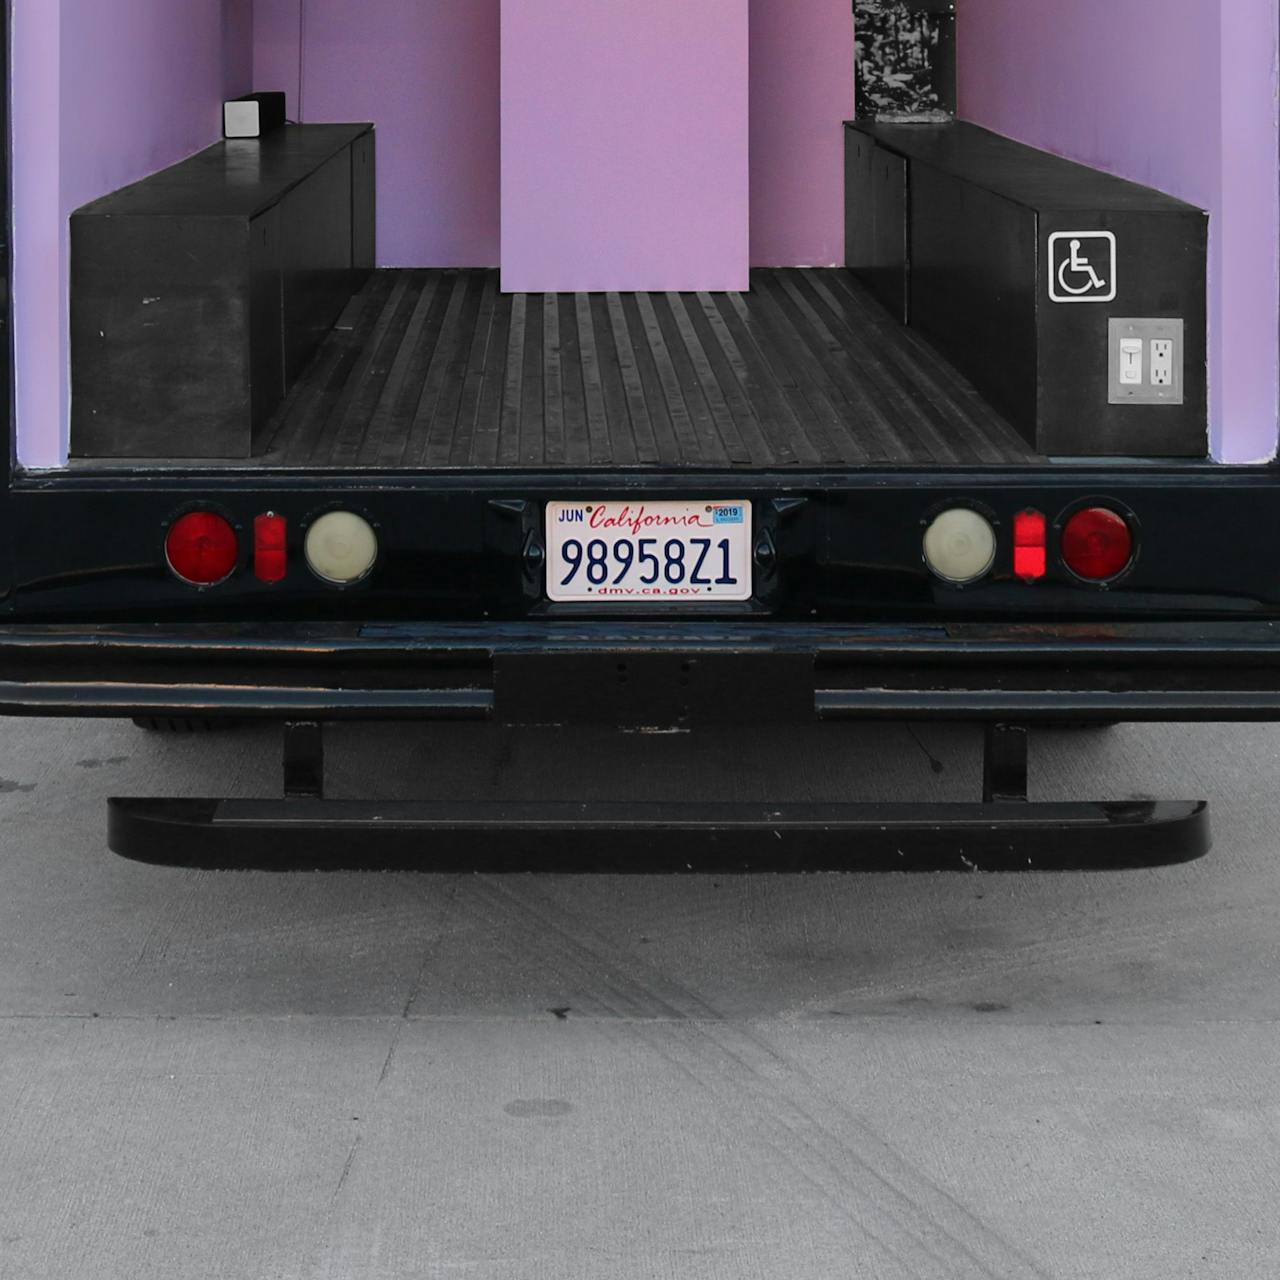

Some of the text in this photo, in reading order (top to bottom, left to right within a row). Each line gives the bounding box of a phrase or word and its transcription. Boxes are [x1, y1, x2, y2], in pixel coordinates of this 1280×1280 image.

[558, 508, 584, 523] JUN
[718, 508, 738, 517] 2019
[589, 505, 714, 536] California
[560, 538, 738, 586] 98958Z1
[597, 586, 701, 596] dmv.ca.gov
